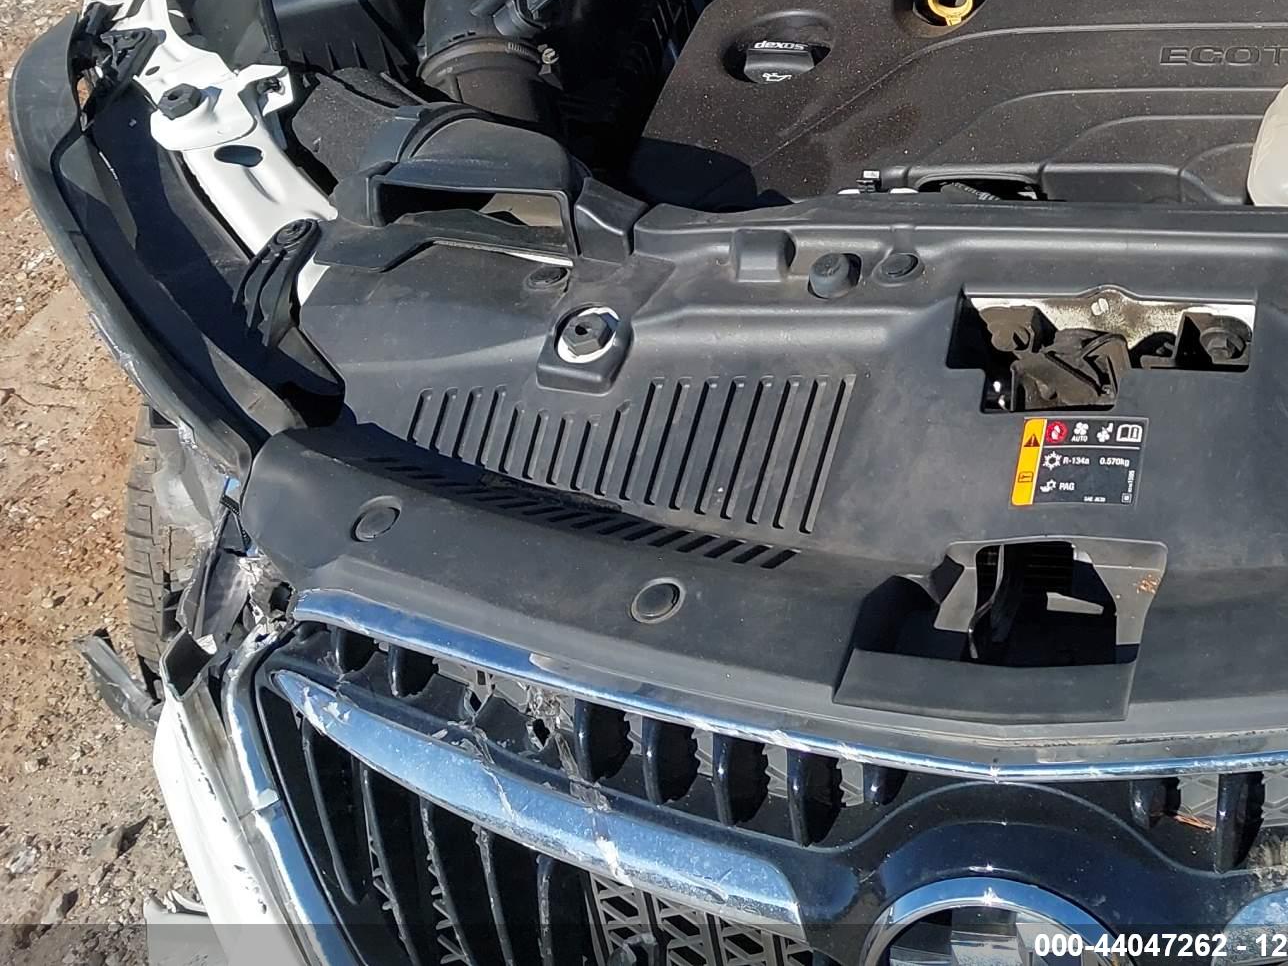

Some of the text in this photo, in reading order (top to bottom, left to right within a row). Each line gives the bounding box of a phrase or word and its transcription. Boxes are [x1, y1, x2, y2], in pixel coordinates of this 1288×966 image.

[754, 40, 808, 51] dexos
[1071, 435, 1088, 443] AUTO
[1062, 456, 1130, 468] R-134a 0.570kg
[1058, 482, 1076, 491] PAG
